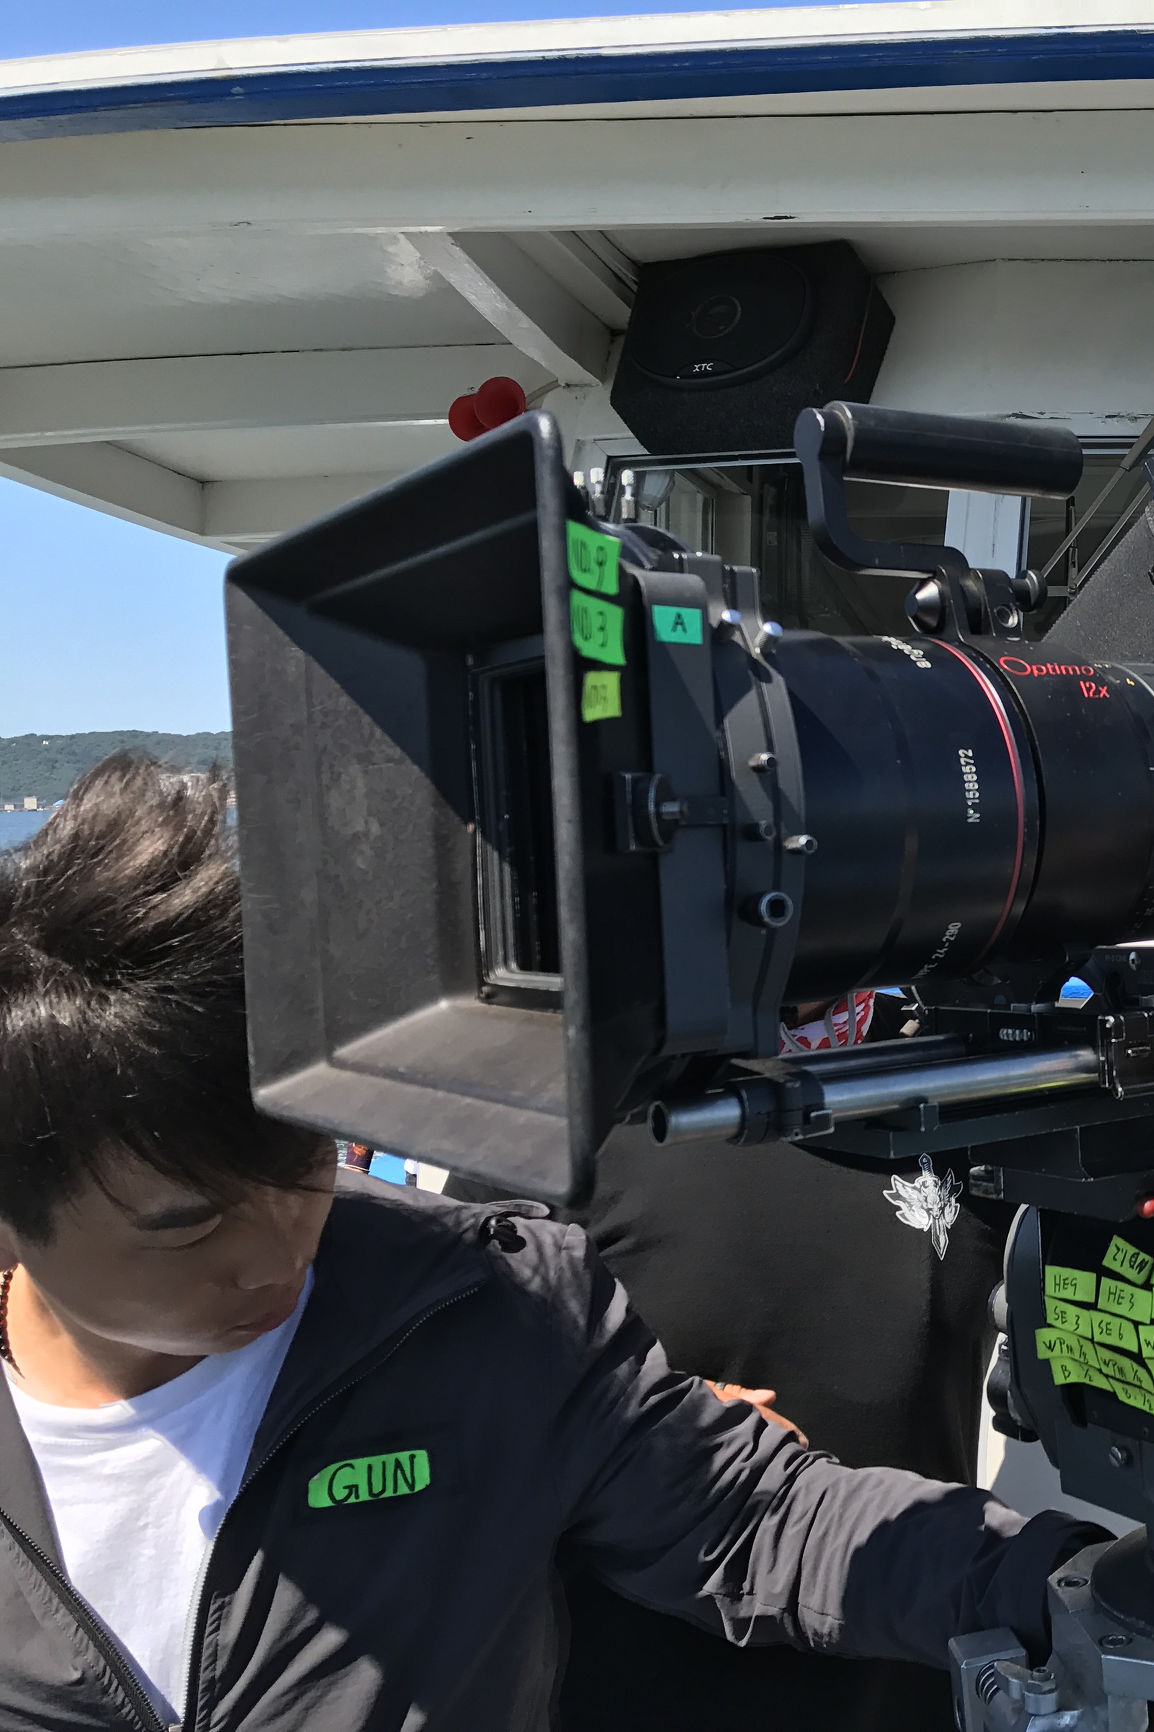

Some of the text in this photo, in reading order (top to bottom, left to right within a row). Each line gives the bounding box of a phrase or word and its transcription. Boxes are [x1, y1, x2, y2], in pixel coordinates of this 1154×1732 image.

[693, 362, 714, 373] XTC
[671, 612, 687, 634] A
[998, 656, 1095, 677] Optimo
[1079, 680, 1110, 698] 12x
[931, 922, 962, 961] 24-290
[1073, 1314, 1080, 1332] 3
[1118, 1322, 1124, 1340] 6
[1061, 1364, 1071, 1379] B
[327, 1453, 417, 1505] GUN
